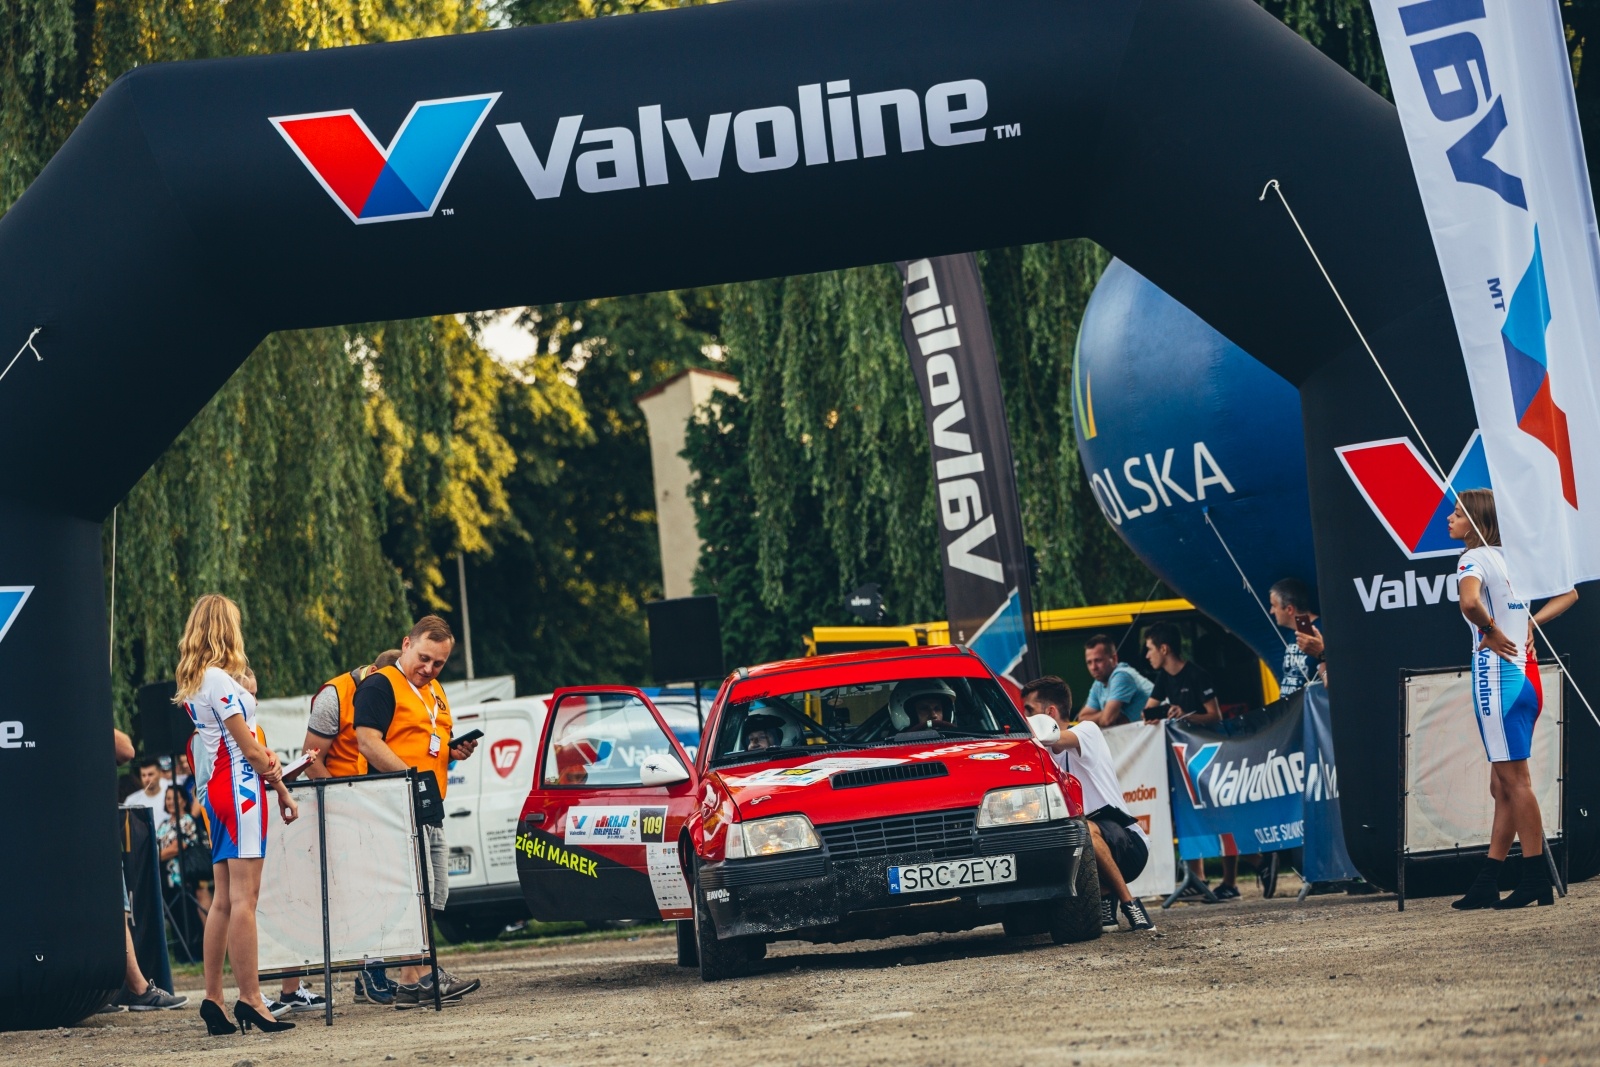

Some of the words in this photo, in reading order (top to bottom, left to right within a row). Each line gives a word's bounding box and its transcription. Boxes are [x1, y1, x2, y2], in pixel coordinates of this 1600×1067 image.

[495, 78, 988, 200] Valvoline
[993, 123, 1021, 139] TM
[1208, 749, 1304, 808] Valvoline
[642, 816, 664, 834] 109
[547, 845, 598, 879] MAREK
[903, 864, 951, 890] SRC
[958, 858, 1013, 885] 2EY3
